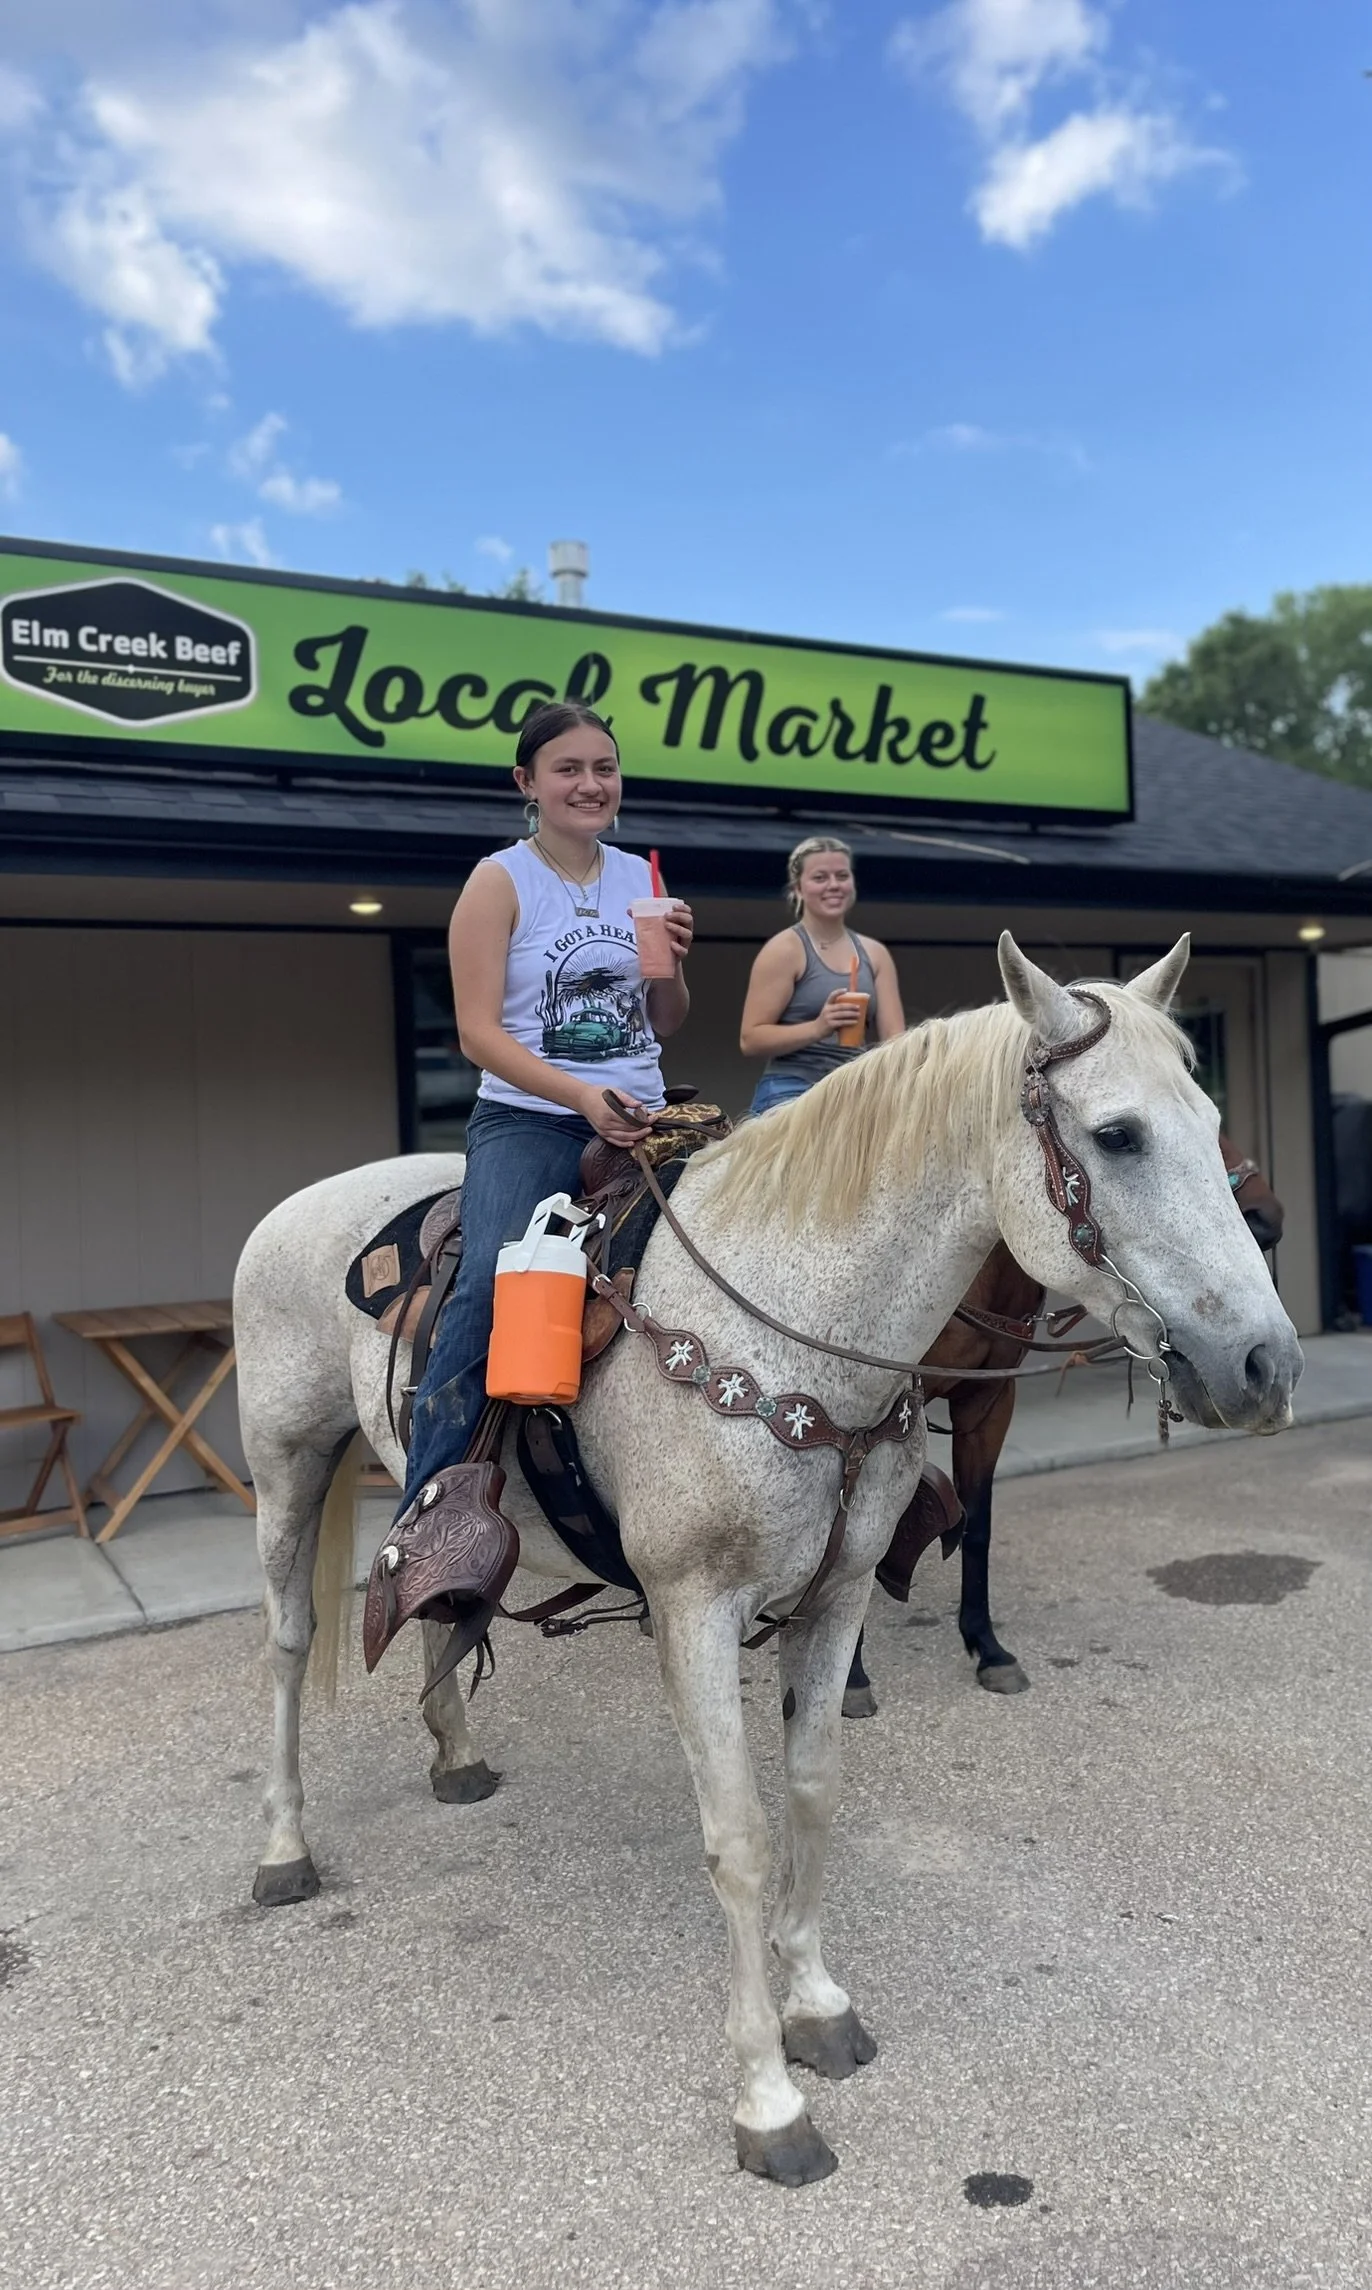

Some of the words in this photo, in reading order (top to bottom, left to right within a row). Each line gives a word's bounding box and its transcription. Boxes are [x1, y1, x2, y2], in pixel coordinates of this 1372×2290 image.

[11, 618, 70, 649] Elm
[78, 625, 169, 659] Creek
[174, 635, 242, 666] Beef
[43, 666, 73, 685] For
[77, 669, 99, 685] the
[101, 672, 175, 695] discerning
[177, 678, 216, 698] buyer
[288, 625, 614, 748] Local
[640, 664, 997, 772] Market
[544, 950, 558, 963] I
[555, 929, 584, 951] GOT
[586, 926, 598, 937] A
[600, 925, 636, 945] HEA
